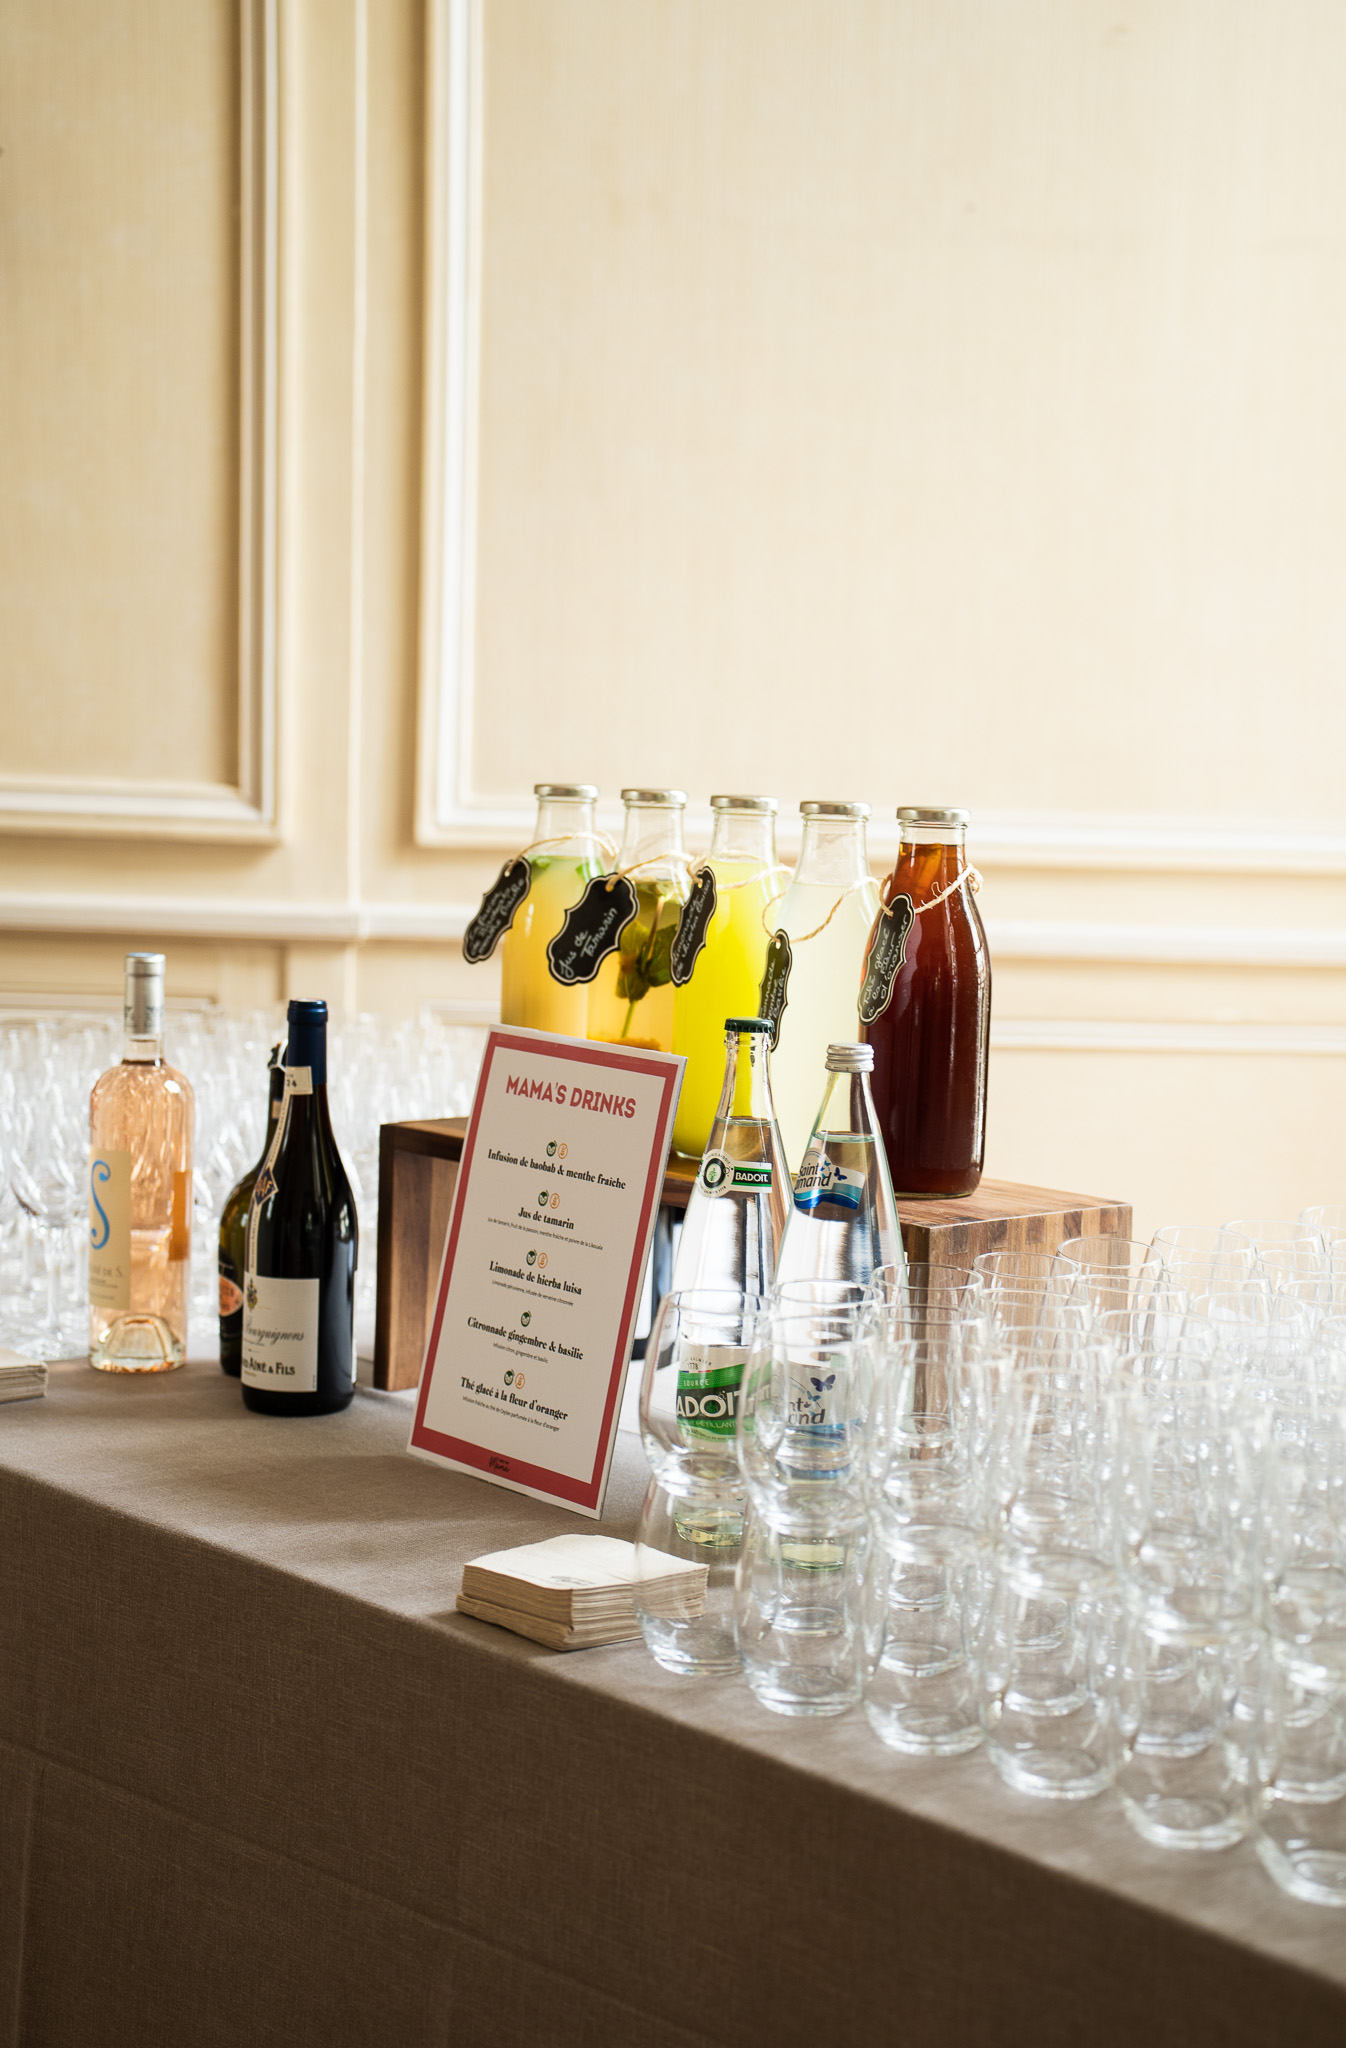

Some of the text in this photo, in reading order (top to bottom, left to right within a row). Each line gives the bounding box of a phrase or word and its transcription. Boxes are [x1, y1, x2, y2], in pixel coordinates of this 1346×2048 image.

[580, 907, 618, 958] Tamarin
[558, 930, 589, 979] Jus de
[506, 1075, 636, 1119] MAMA'S DRINKS
[488, 1149, 518, 1165] Infusion
[519, 1156, 529, 1167] de
[529, 1158, 556, 1173] baobab
[557, 1165, 565, 1176] &
[566, 1170, 596, 1183] menthe
[91, 1160, 111, 1250] S
[518, 1207, 574, 1230] Jus de tamarin
[489, 1261, 582, 1295] Limonade de hierba luisa
[467, 1317, 507, 1337] Citronnade
[508, 1329, 547, 1349] gingembre
[548, 1341, 556, 1352] &
[276, 1362, 295, 1375] FILS
[461, 1376, 568, 1420] Thé glacé à la fleur d'oranger
